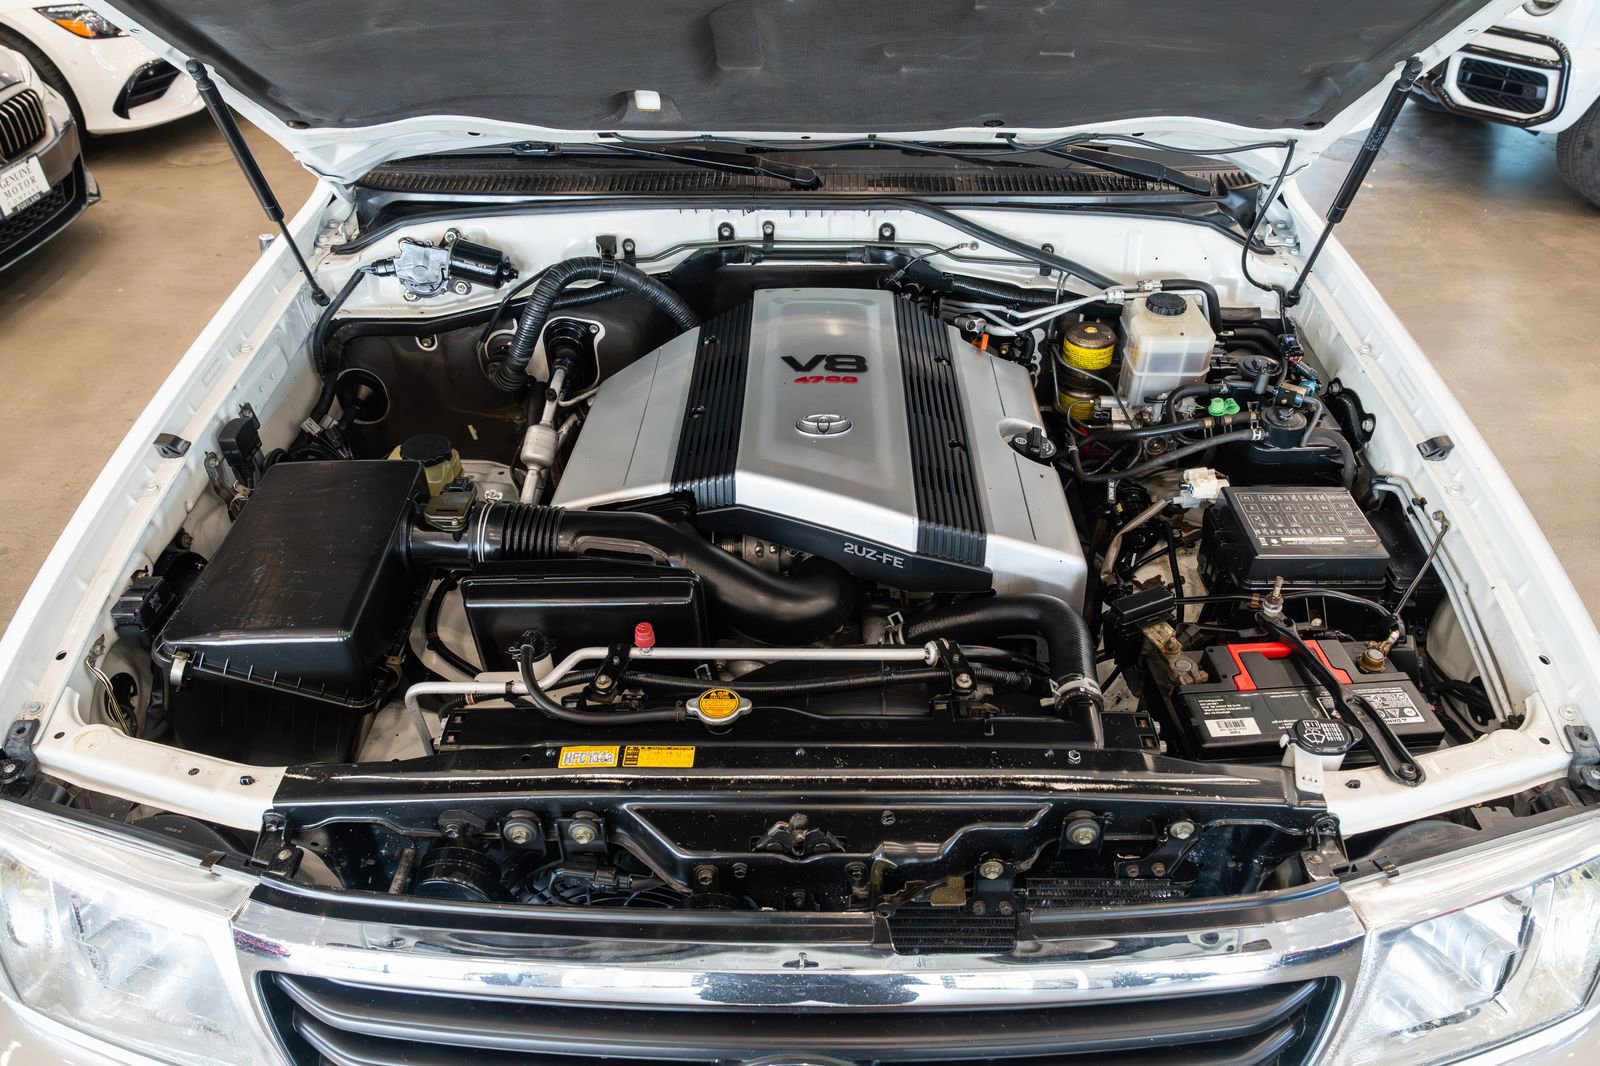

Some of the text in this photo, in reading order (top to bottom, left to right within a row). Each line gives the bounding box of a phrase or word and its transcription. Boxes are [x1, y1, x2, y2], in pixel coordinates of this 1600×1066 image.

[0, 165, 32, 190] GENUINE
[4, 175, 37, 198] MOTOR
[780, 354, 868, 373] V8
[843, 542, 905, 569] 2UZ-FE
